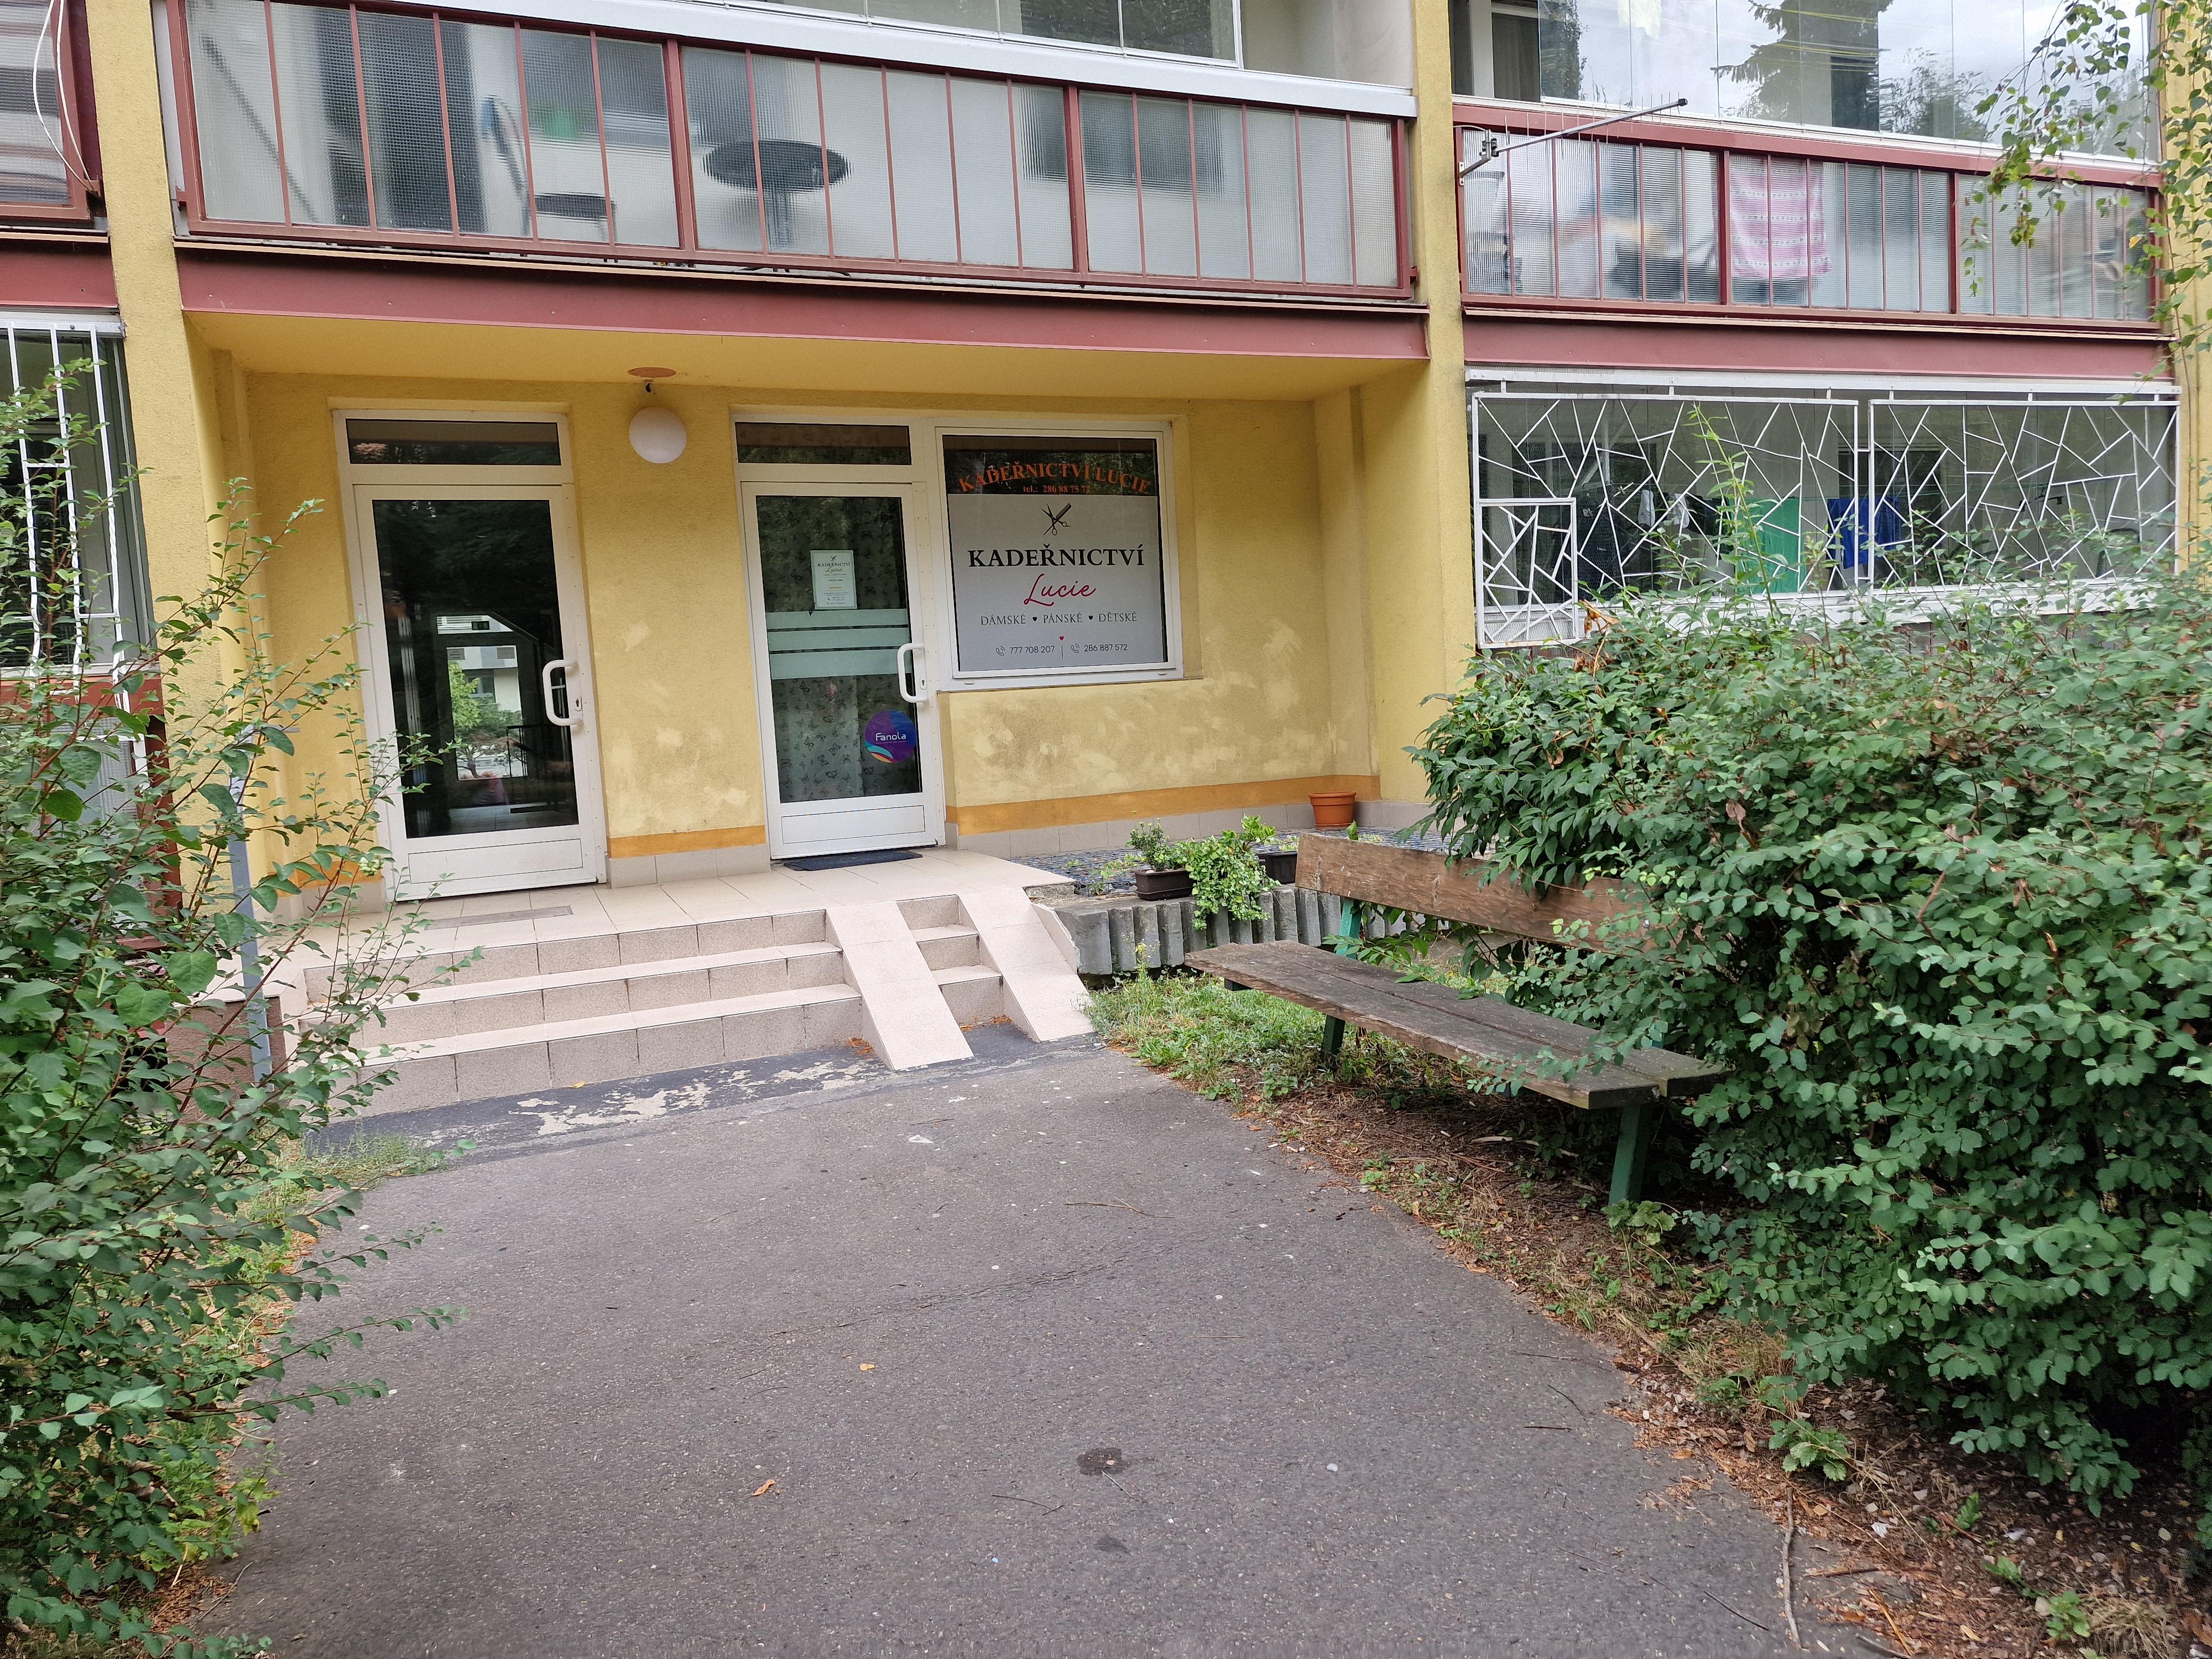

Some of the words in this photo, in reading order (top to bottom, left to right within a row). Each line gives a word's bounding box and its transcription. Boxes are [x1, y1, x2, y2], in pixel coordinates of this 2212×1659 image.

[958, 460, 1089, 493] KADEŘNICTVÍ
[1096, 467, 1151, 494] LUCIE
[968, 543, 1145, 567] KADEŘNICTVÍ
[1023, 573, 1097, 607] Lucie
[980, 613, 1026, 625] DÁMSKÉ
[1043, 612, 1082, 624] PÁNSKÉ
[1098, 611, 1138, 622] DĚTSKÉ
[875, 732, 906, 741] Fanola
